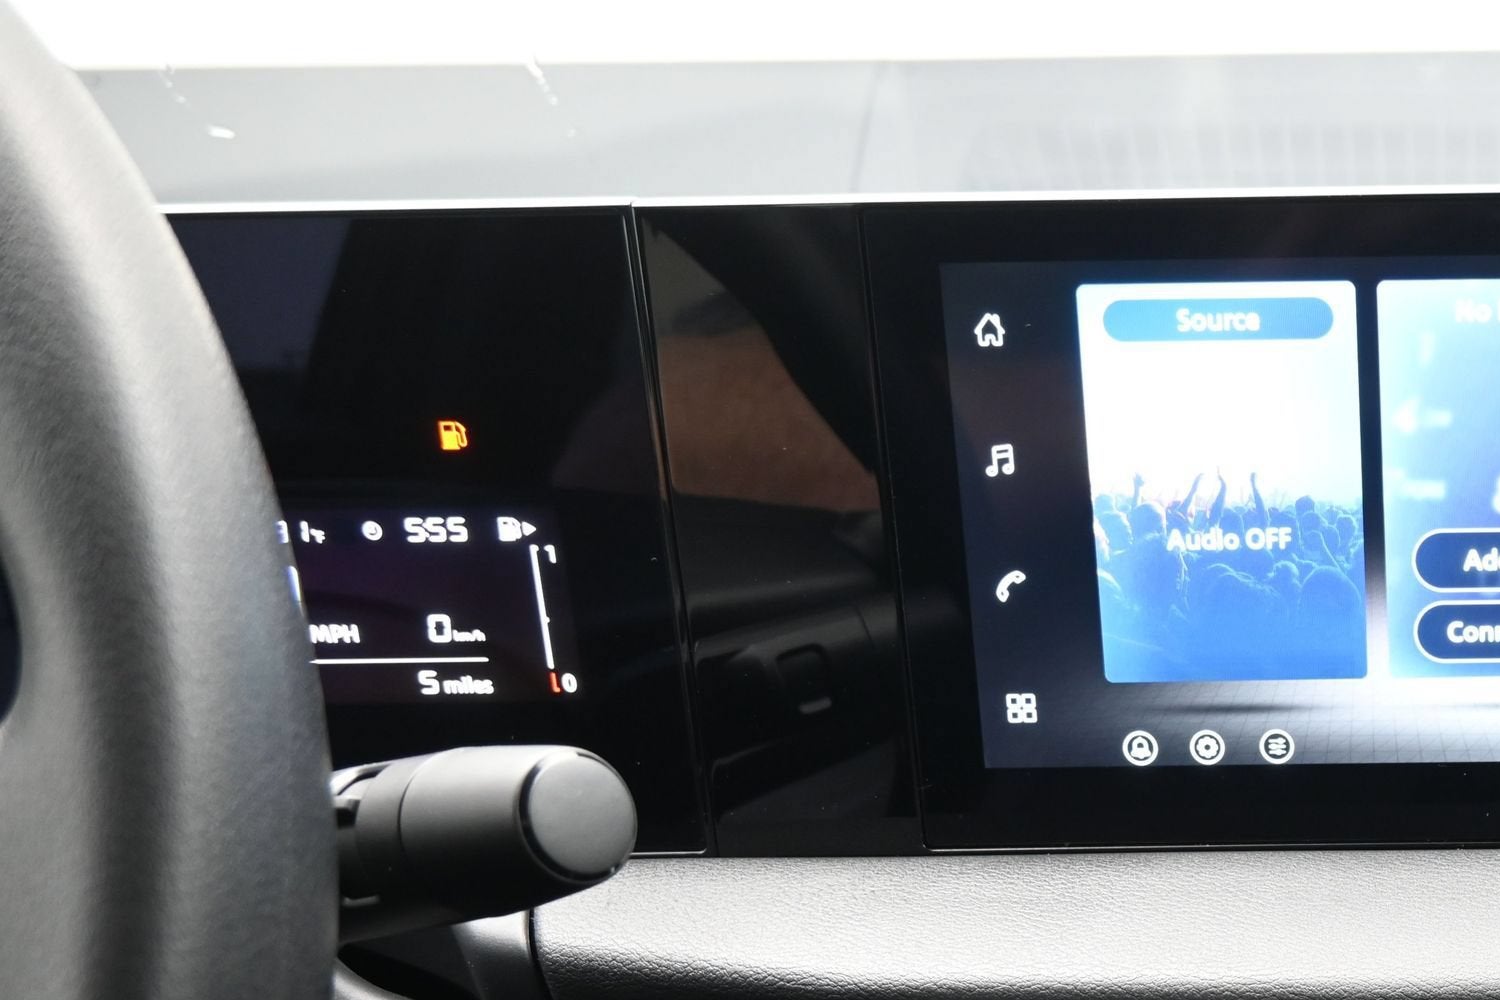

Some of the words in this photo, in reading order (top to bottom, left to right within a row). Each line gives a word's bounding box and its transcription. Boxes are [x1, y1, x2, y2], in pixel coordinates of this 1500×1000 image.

[1175, 307, 1261, 332] Source
[1455, 298, 1493, 323] No
[1166, 526, 1241, 552] Audio
[1244, 526, 1293, 551] OFF
[308, 623, 361, 644] MPH
[417, 670, 441, 695] 5
[442, 675, 495, 695] miles
